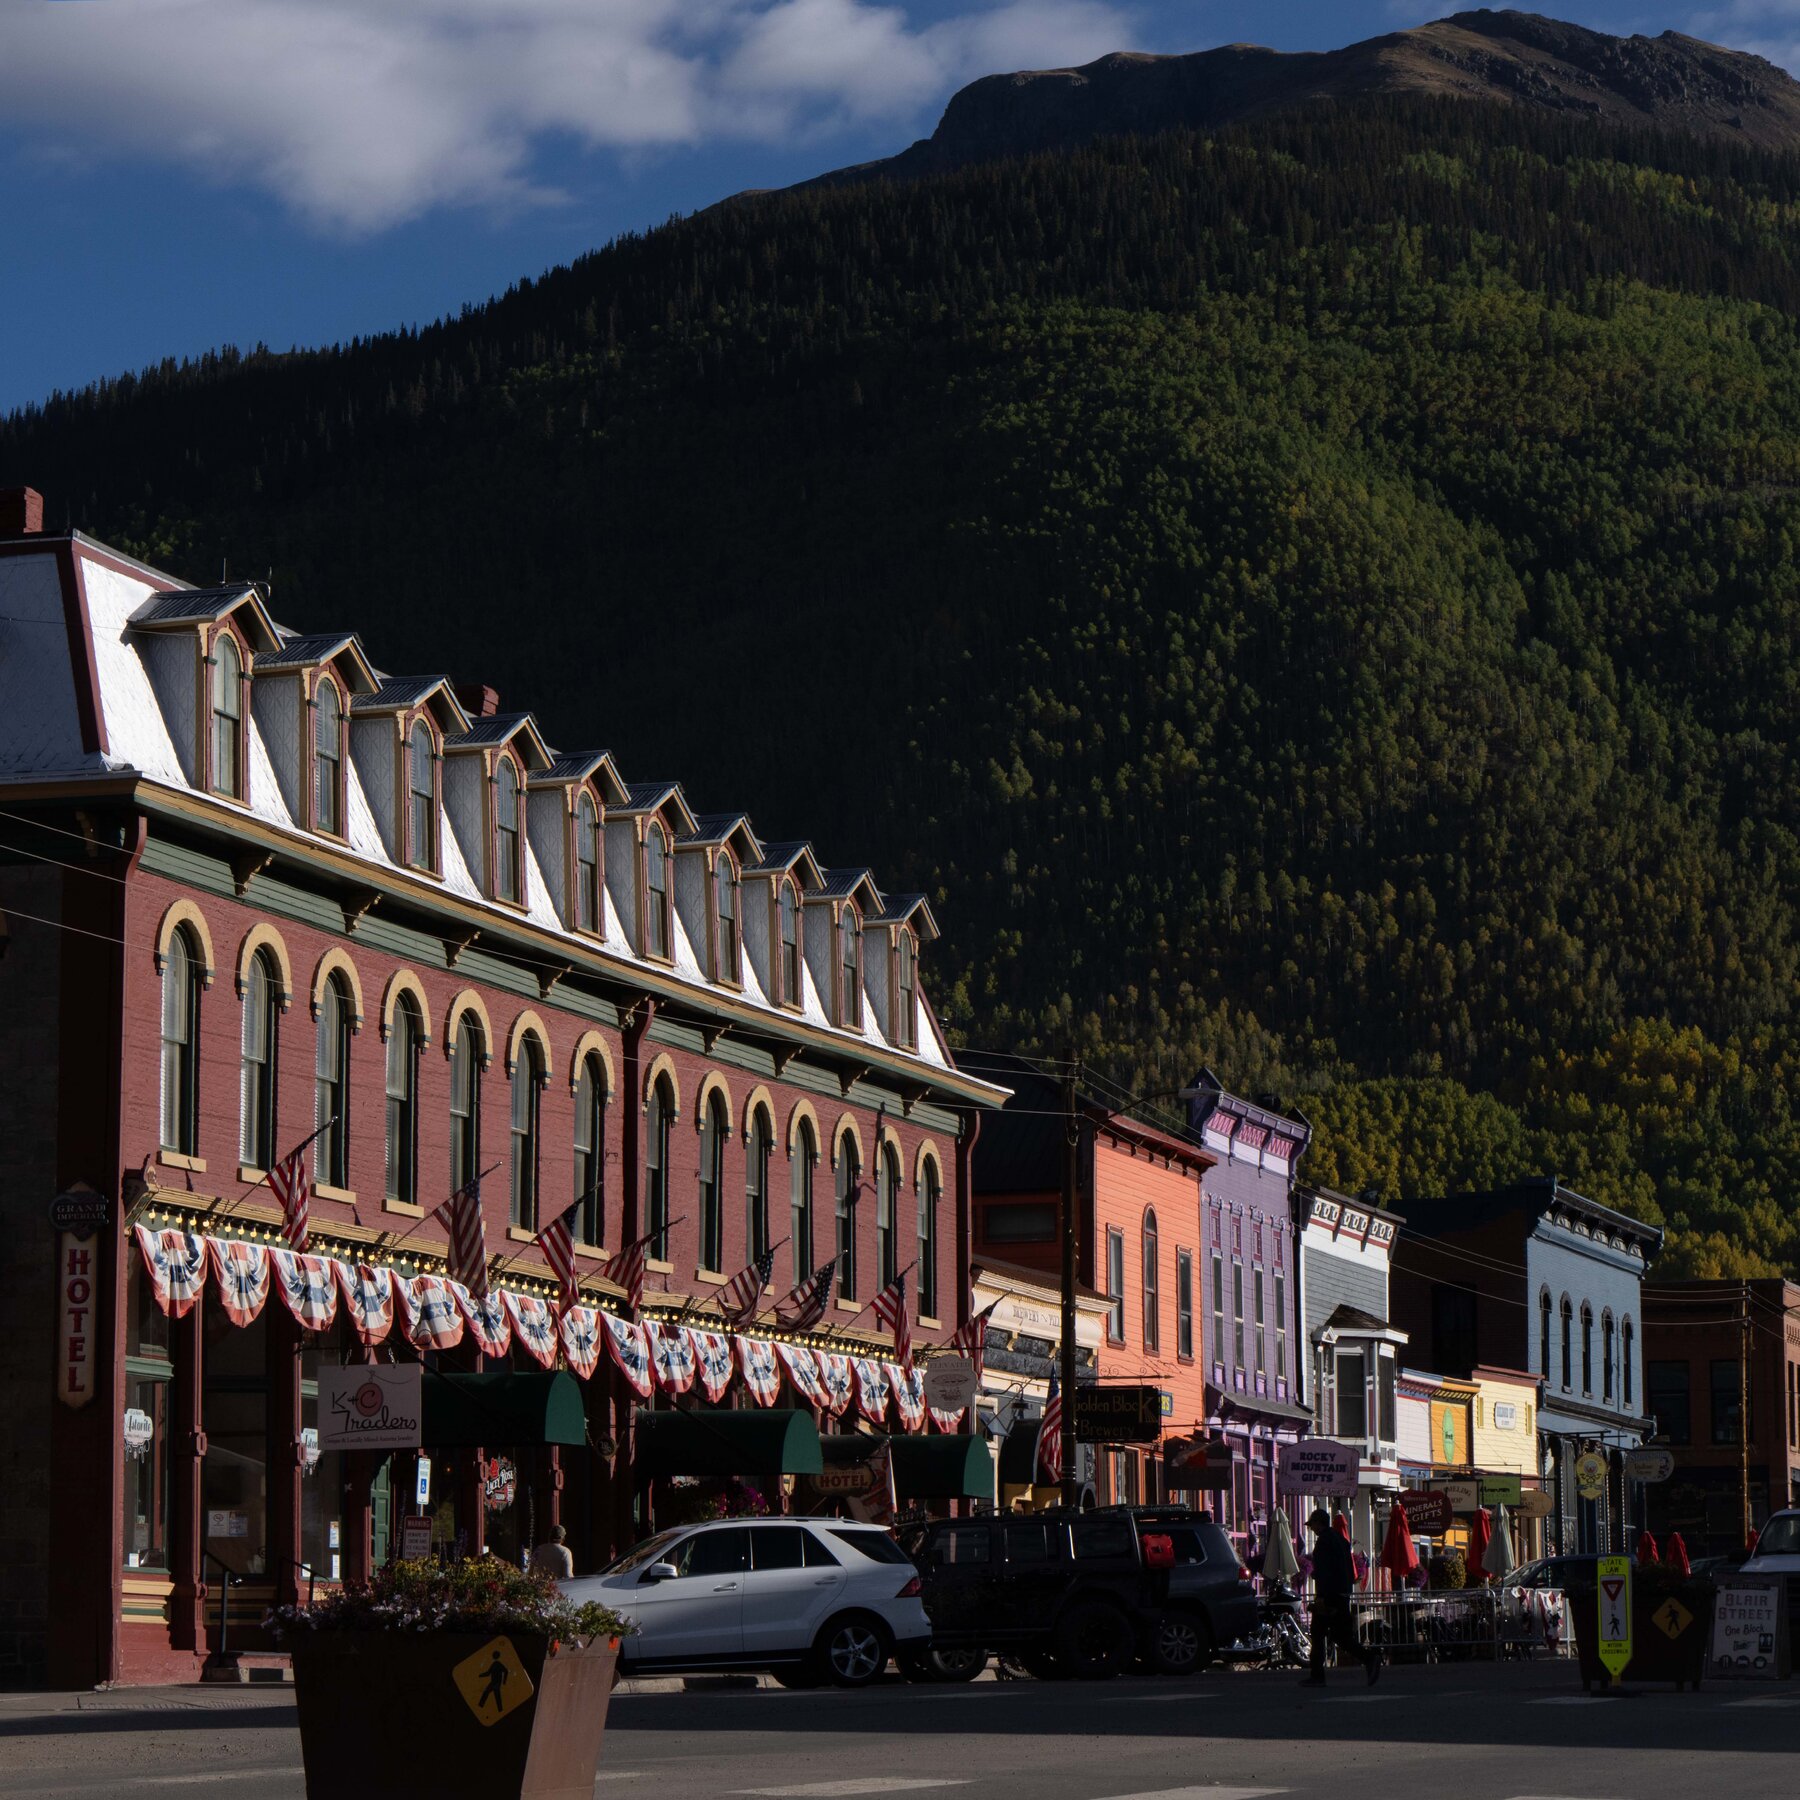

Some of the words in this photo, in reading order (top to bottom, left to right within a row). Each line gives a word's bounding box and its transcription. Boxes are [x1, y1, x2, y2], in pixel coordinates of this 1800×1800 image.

[57, 1204, 103, 1213] GRAND
[68, 1249, 90, 1393] HOTEL
[331, 1405, 417, 1433] Traders
[1080, 1419, 1135, 1438] Brewery
[1300, 1452, 1336, 1461] ROCKY
[1291, 1462, 1347, 1473] MOUNTAIN
[820, 1474, 868, 1488] HOTEL
[1302, 1473, 1333, 1482] GIFTS
[1412, 1508, 1443, 1522] GIFTS
[1605, 1566, 1619, 1574] LAW
[1725, 1593, 1768, 1606] BLAIR
[1718, 1607, 1774, 1620] STREET
[1725, 1625, 1740, 1636] One
[1743, 1624, 1765, 1635] Block
